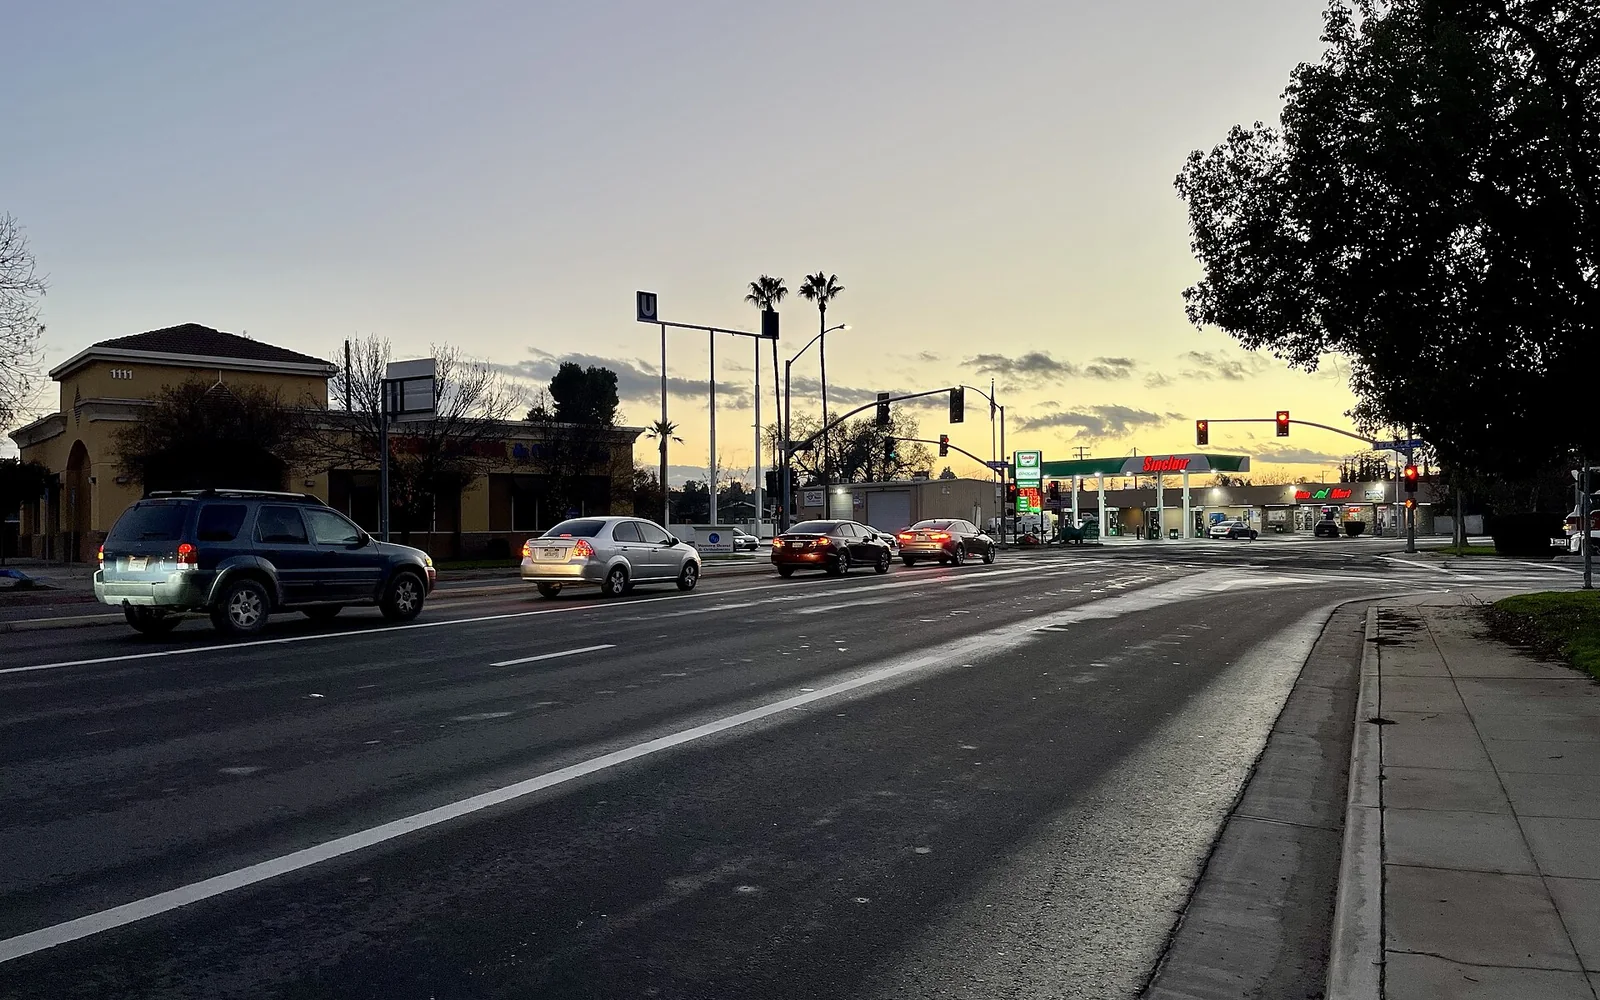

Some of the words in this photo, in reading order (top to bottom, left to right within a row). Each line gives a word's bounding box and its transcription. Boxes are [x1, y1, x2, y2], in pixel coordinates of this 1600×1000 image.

[641, 294, 655, 317] U
[110, 369, 133, 379] 1111
[1143, 455, 1190, 472] Sinclair
[1331, 488, 1352, 499] Mart
